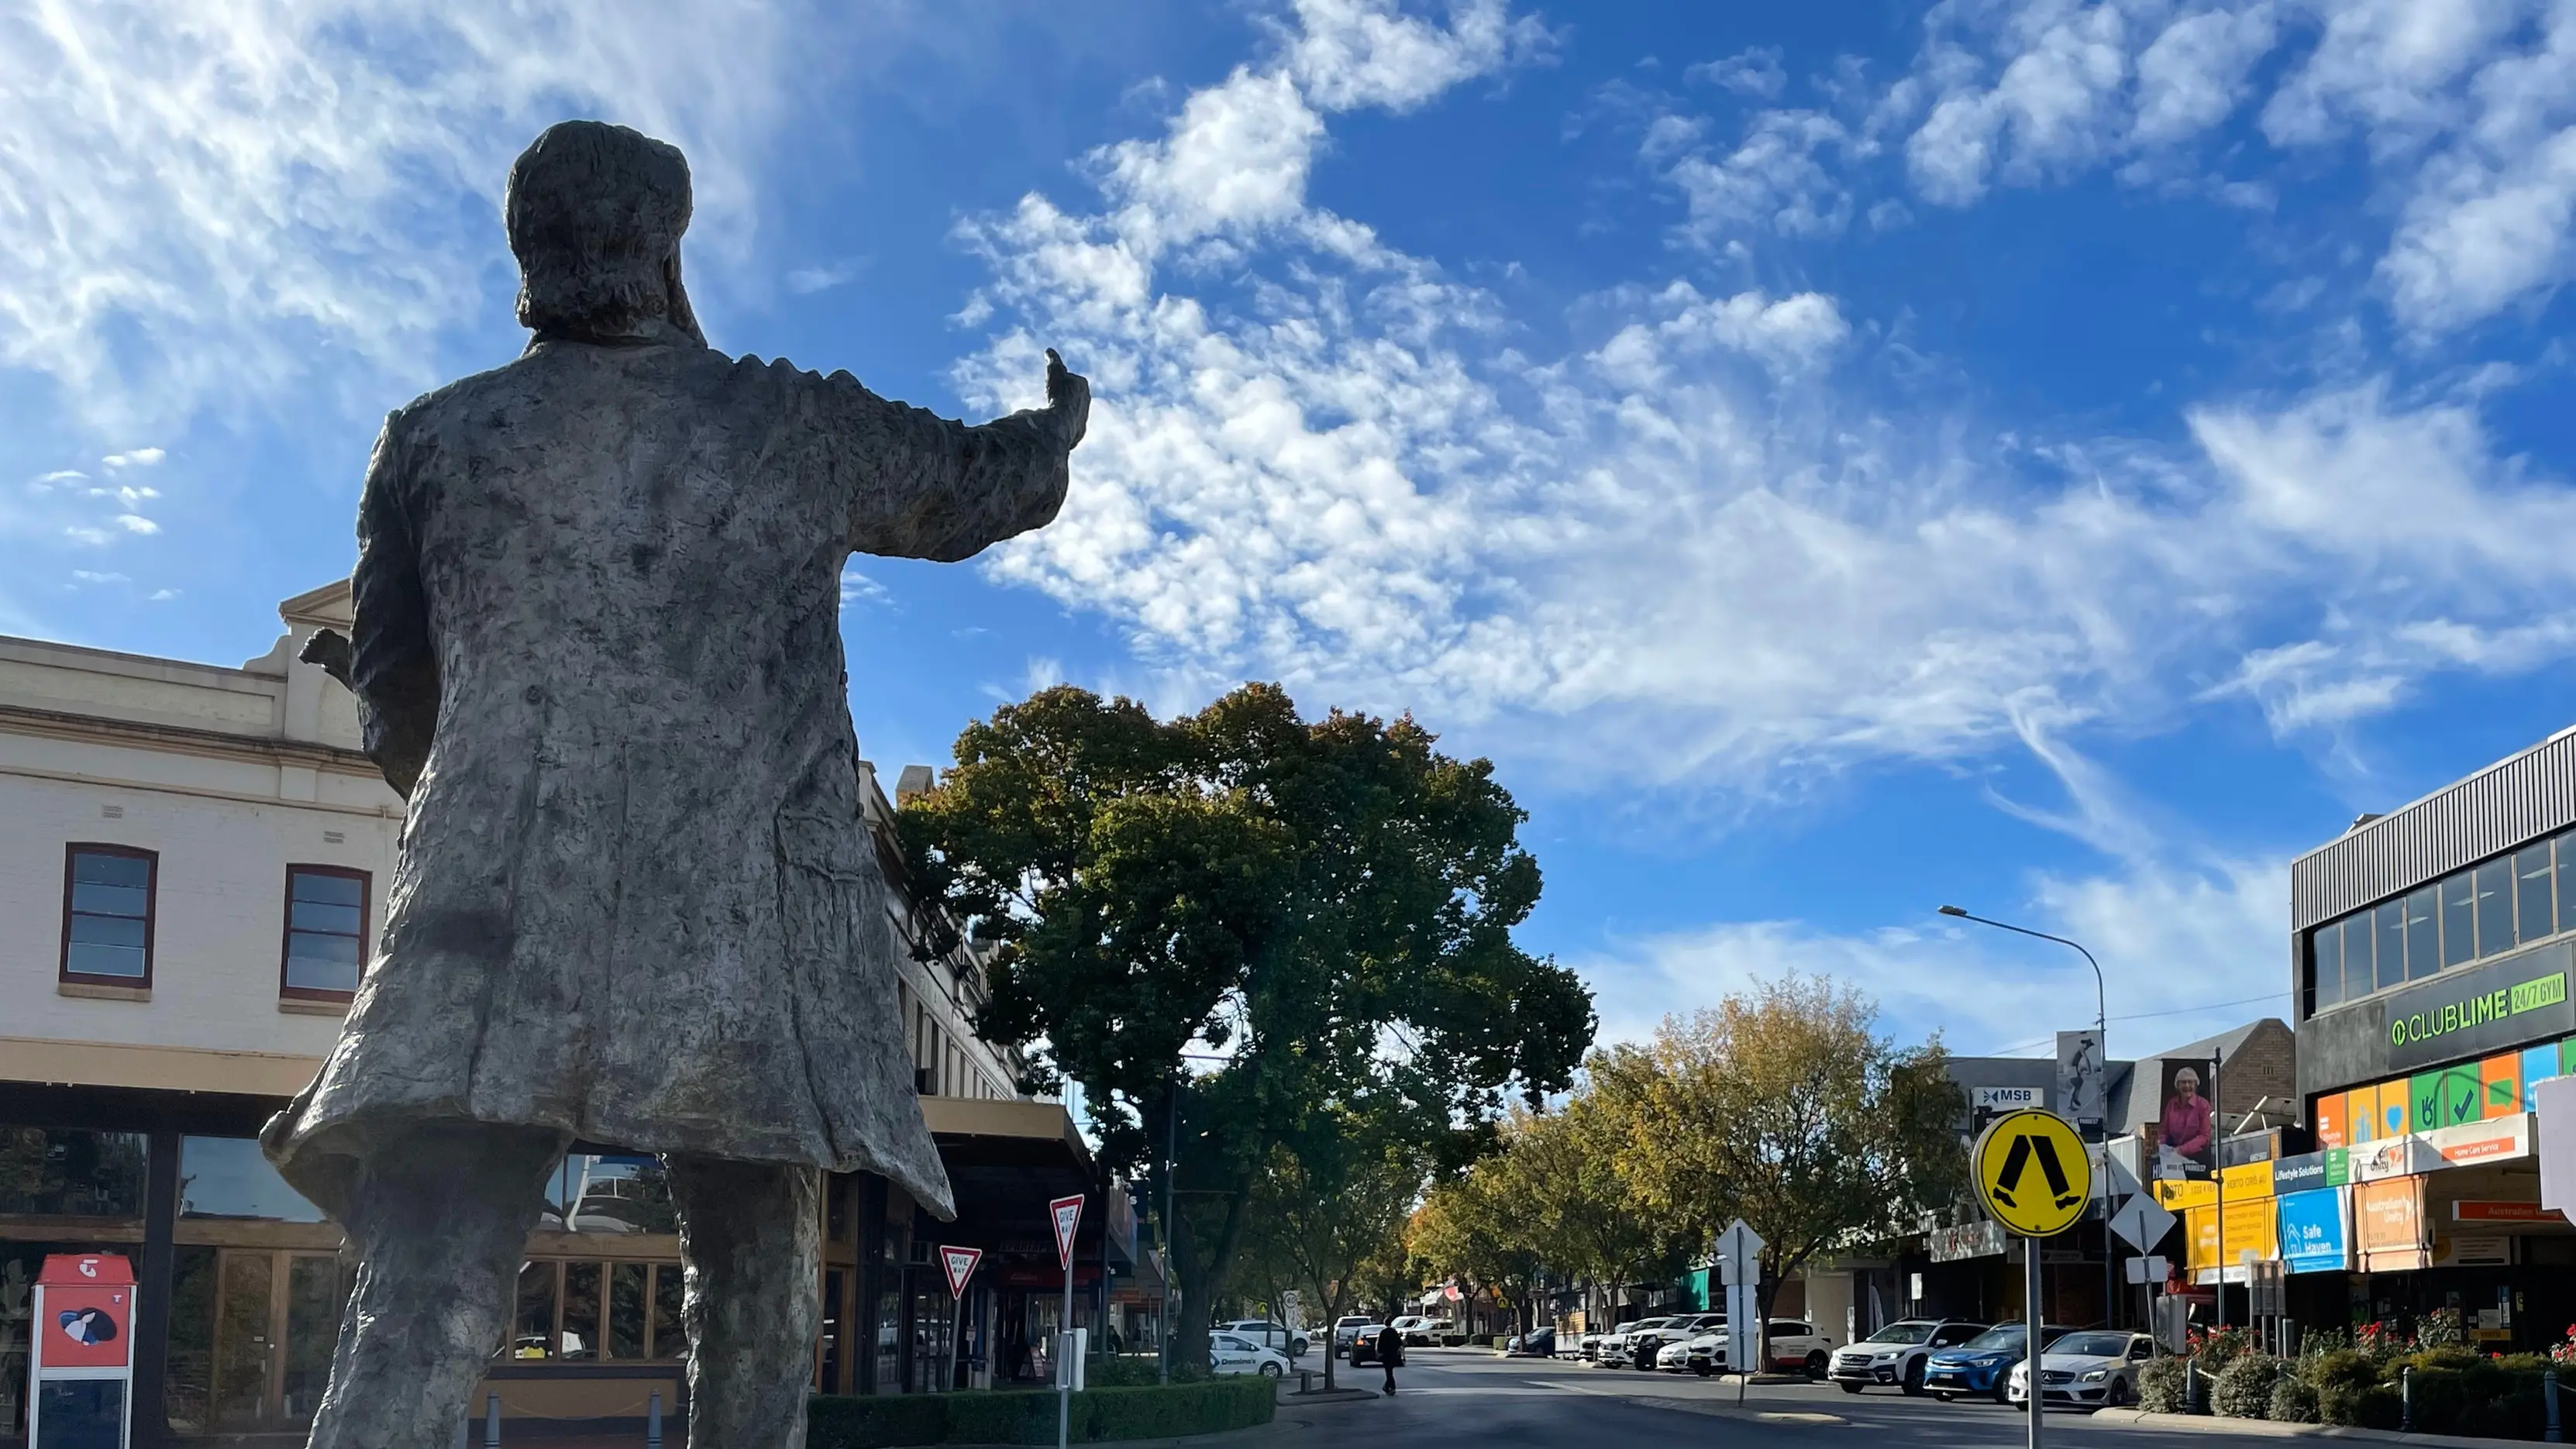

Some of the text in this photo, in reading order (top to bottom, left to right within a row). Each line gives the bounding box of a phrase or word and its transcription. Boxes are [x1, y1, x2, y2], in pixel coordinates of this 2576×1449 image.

[2409, 977, 2562, 1042] CLUBLIME 24/7 GYM
[2000, 1089, 2032, 1101] MSB
[2469, 1146, 2481, 1155] Care
[2481, 1143, 2499, 1153] Service
[2275, 1168, 2299, 1182] Lifestyle
[2299, 1164, 2324, 1178] Solutions
[1059, 1210, 1074, 1224] GIVE
[2488, 1206, 2534, 1217] Australian
[1061, 1225, 1071, 1234] WAY
[2302, 1224, 2323, 1239] Safe
[2305, 1241, 2332, 1254] Haven
[951, 1256, 969, 1266] GIVE
[1221, 1358, 1257, 1366] Domino's
